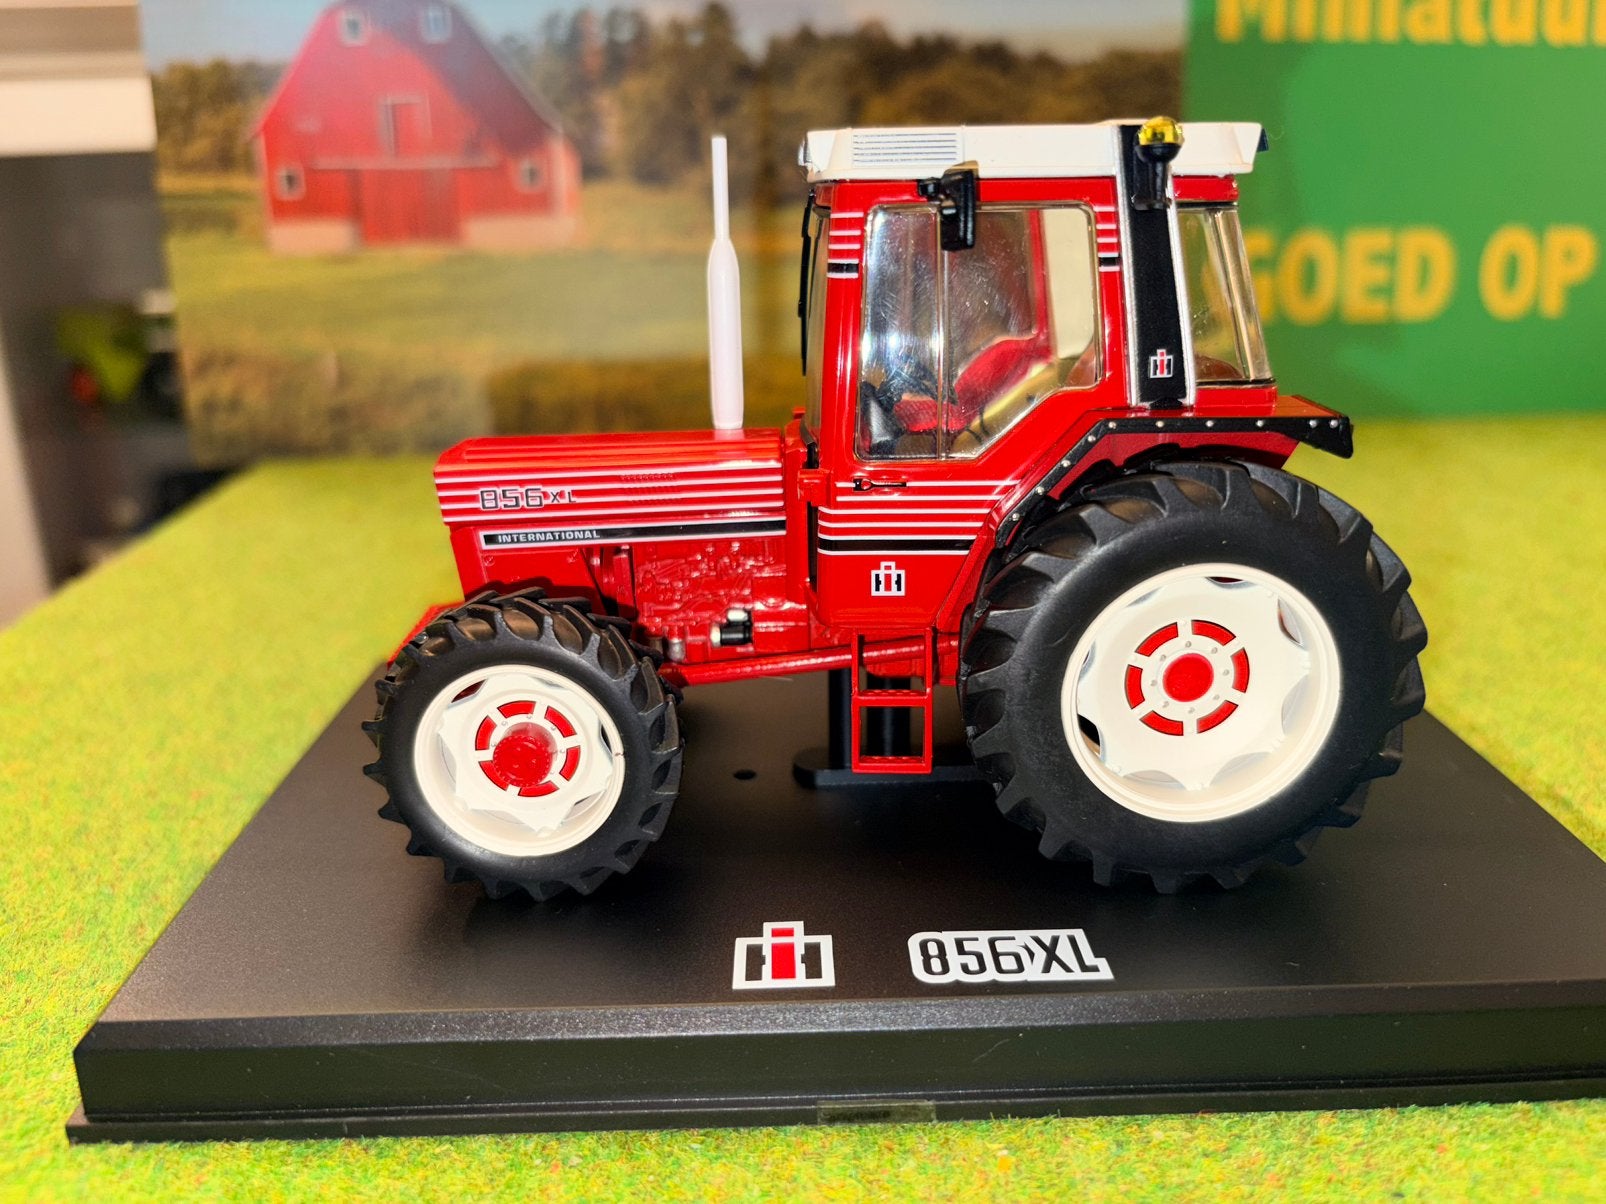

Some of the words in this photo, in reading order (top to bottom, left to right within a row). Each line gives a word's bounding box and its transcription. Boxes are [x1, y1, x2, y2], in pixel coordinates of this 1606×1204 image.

[1214, 0, 1606, 45] Miniatuu
[1479, 224, 1597, 322] OP
[497, 529, 601, 544] INTERNATIONAL
